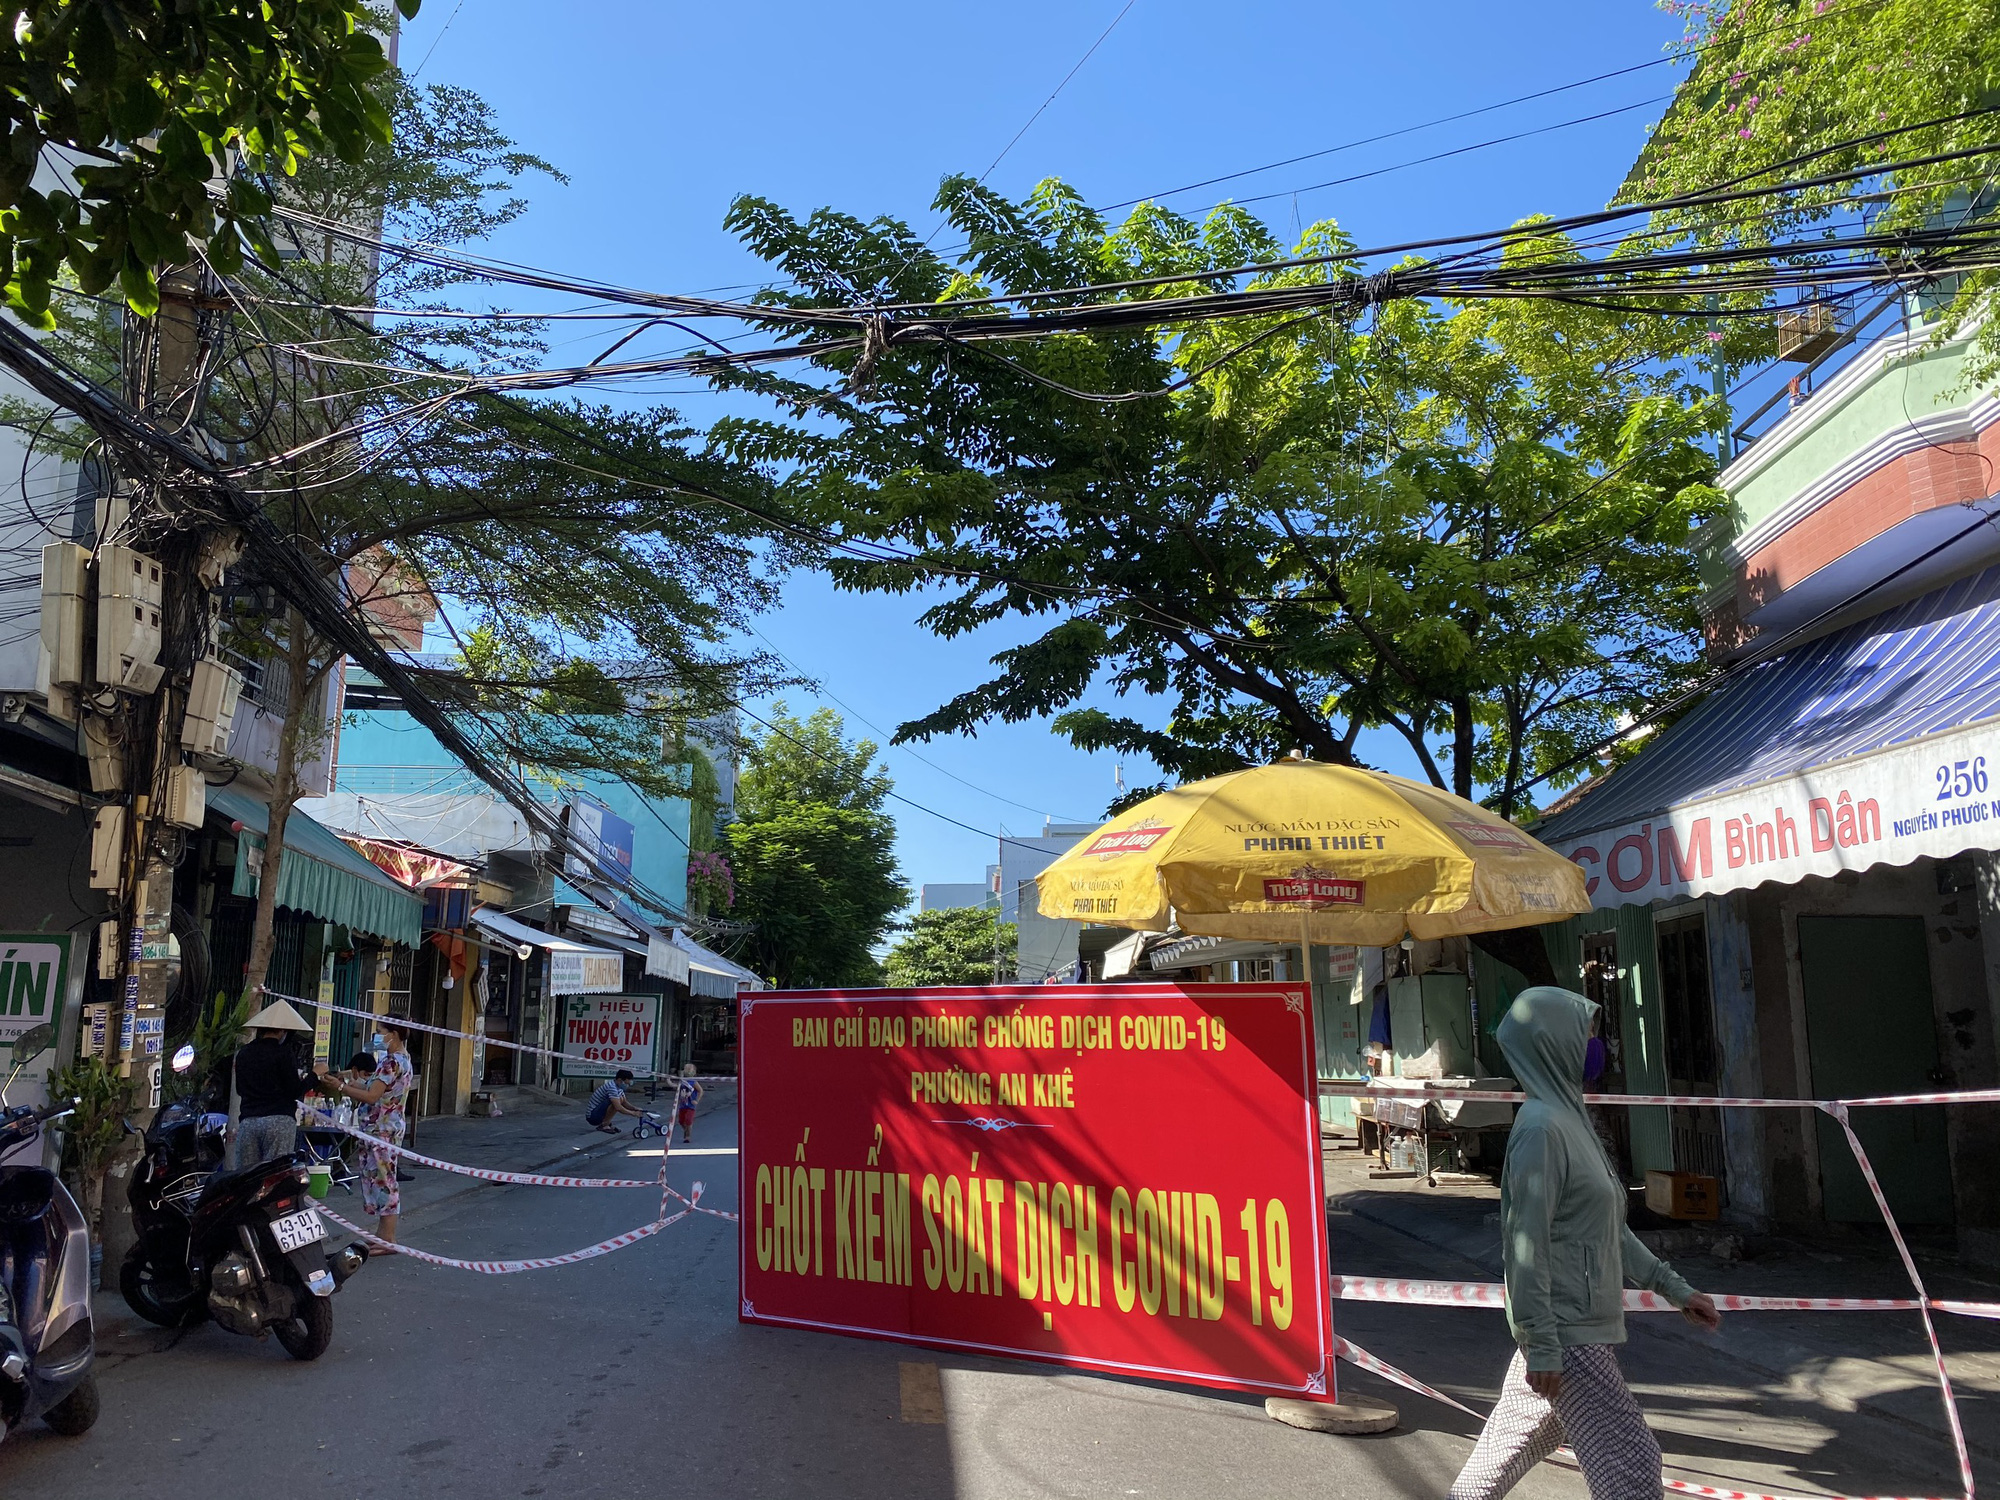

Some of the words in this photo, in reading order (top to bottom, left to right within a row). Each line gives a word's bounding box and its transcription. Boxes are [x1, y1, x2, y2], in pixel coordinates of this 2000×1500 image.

[1936, 756, 1989, 801] 256
[1224, 821, 1276, 834] NƯỚC
[1281, 818, 1321, 831] MẮM
[1326, 819, 1362, 832] ĐẶC
[1367, 816, 1400, 830] SẢN
[1893, 808, 1938, 838] NGUYỄN
[1942, 801, 1989, 828] PHƯỚC
[1092, 835, 1126, 851] Thái
[1123, 832, 1161, 858] Long
[1244, 837, 1312, 851] PHAN
[1318, 832, 1386, 850] THIẾT
[1566, 816, 1715, 901] CƠM
[1725, 806, 1800, 869] Bình
[1808, 789, 1882, 854] Dân
[1268, 881, 1311, 897] Thái
[1313, 883, 1358, 900] Long
[600, 999, 644, 1015] HIỆU
[5, 1028, 23, 1039] 768
[568, 1015, 619, 1045] THUỐC
[624, 1016, 653, 1046] TÂY
[792, 1017, 828, 1047] BAN
[834, 1007, 864, 1047] CHỈ
[869, 1017, 905, 1054] ĐẠO
[912, 1008, 978, 1048] PHÒNG
[984, 1004, 1055, 1049] CHỐNG
[1061, 1015, 1112, 1056] DỊCH
[1119, 1015, 1226, 1051] COVID-19
[584, 1047, 632, 1062] 609
[911, 1064, 991, 1105] PHƯỜNG
[998, 1073, 1026, 1107] AN
[1033, 1067, 1075, 1108] KHÊ
[279, 1212, 313, 1235] 43-D1
[756, 1127, 826, 1277] CHỐT
[834, 1124, 913, 1287] KIỂM
[922, 1151, 1005, 1297] SOÁT
[1014, 1180, 1101, 1331] DỊCH
[1110, 1185, 1293, 1331] COVID-19
[280, 1224, 325, 1250] 674.72
